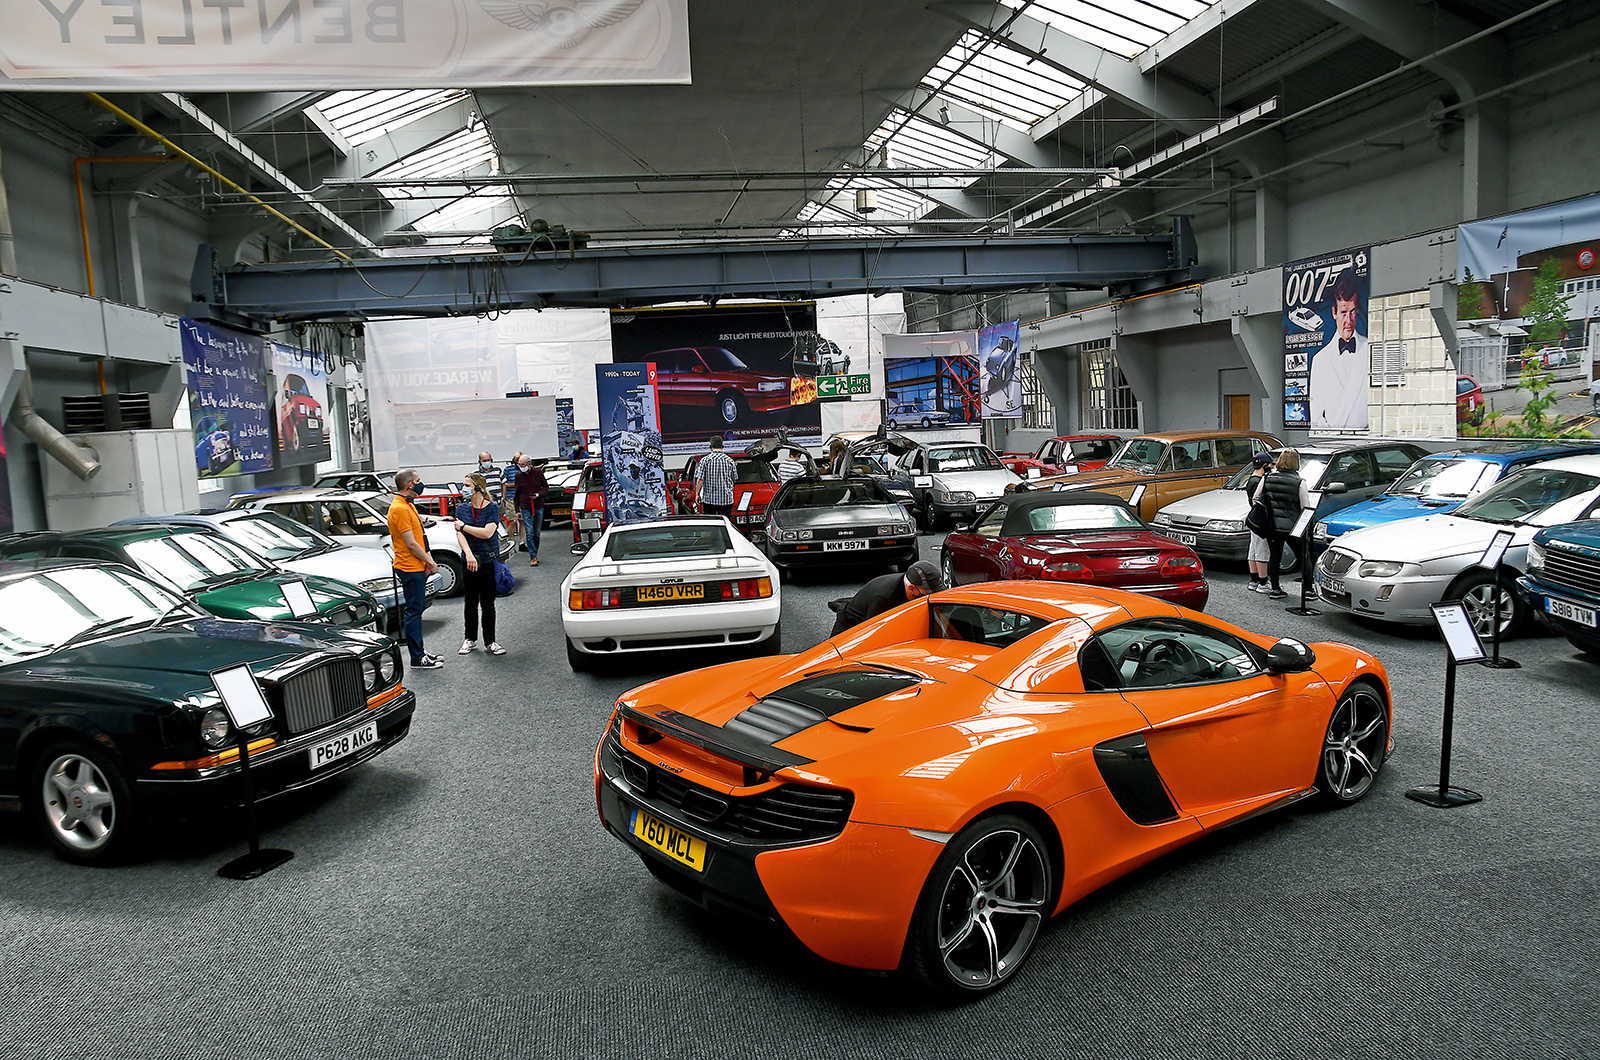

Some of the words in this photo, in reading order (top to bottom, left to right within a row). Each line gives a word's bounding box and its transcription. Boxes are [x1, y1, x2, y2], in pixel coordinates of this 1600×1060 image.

[1328, 254, 1352, 264] COLLECTION
[1286, 266, 1331, 307] 007
[650, 370, 655, 380] 9
[850, 376, 869, 385] Fire
[851, 384, 869, 393] exit
[622, 440, 640, 448] JAGUAR
[639, 586, 673, 599] H460
[676, 585, 702, 596] VRR
[1552, 601, 1572, 618] S818
[1574, 607, 1593, 624] TVM
[317, 737, 349, 764] P628
[352, 727, 374, 750] AKG
[642, 813, 666, 846] Y60
[666, 828, 695, 864] MCL
